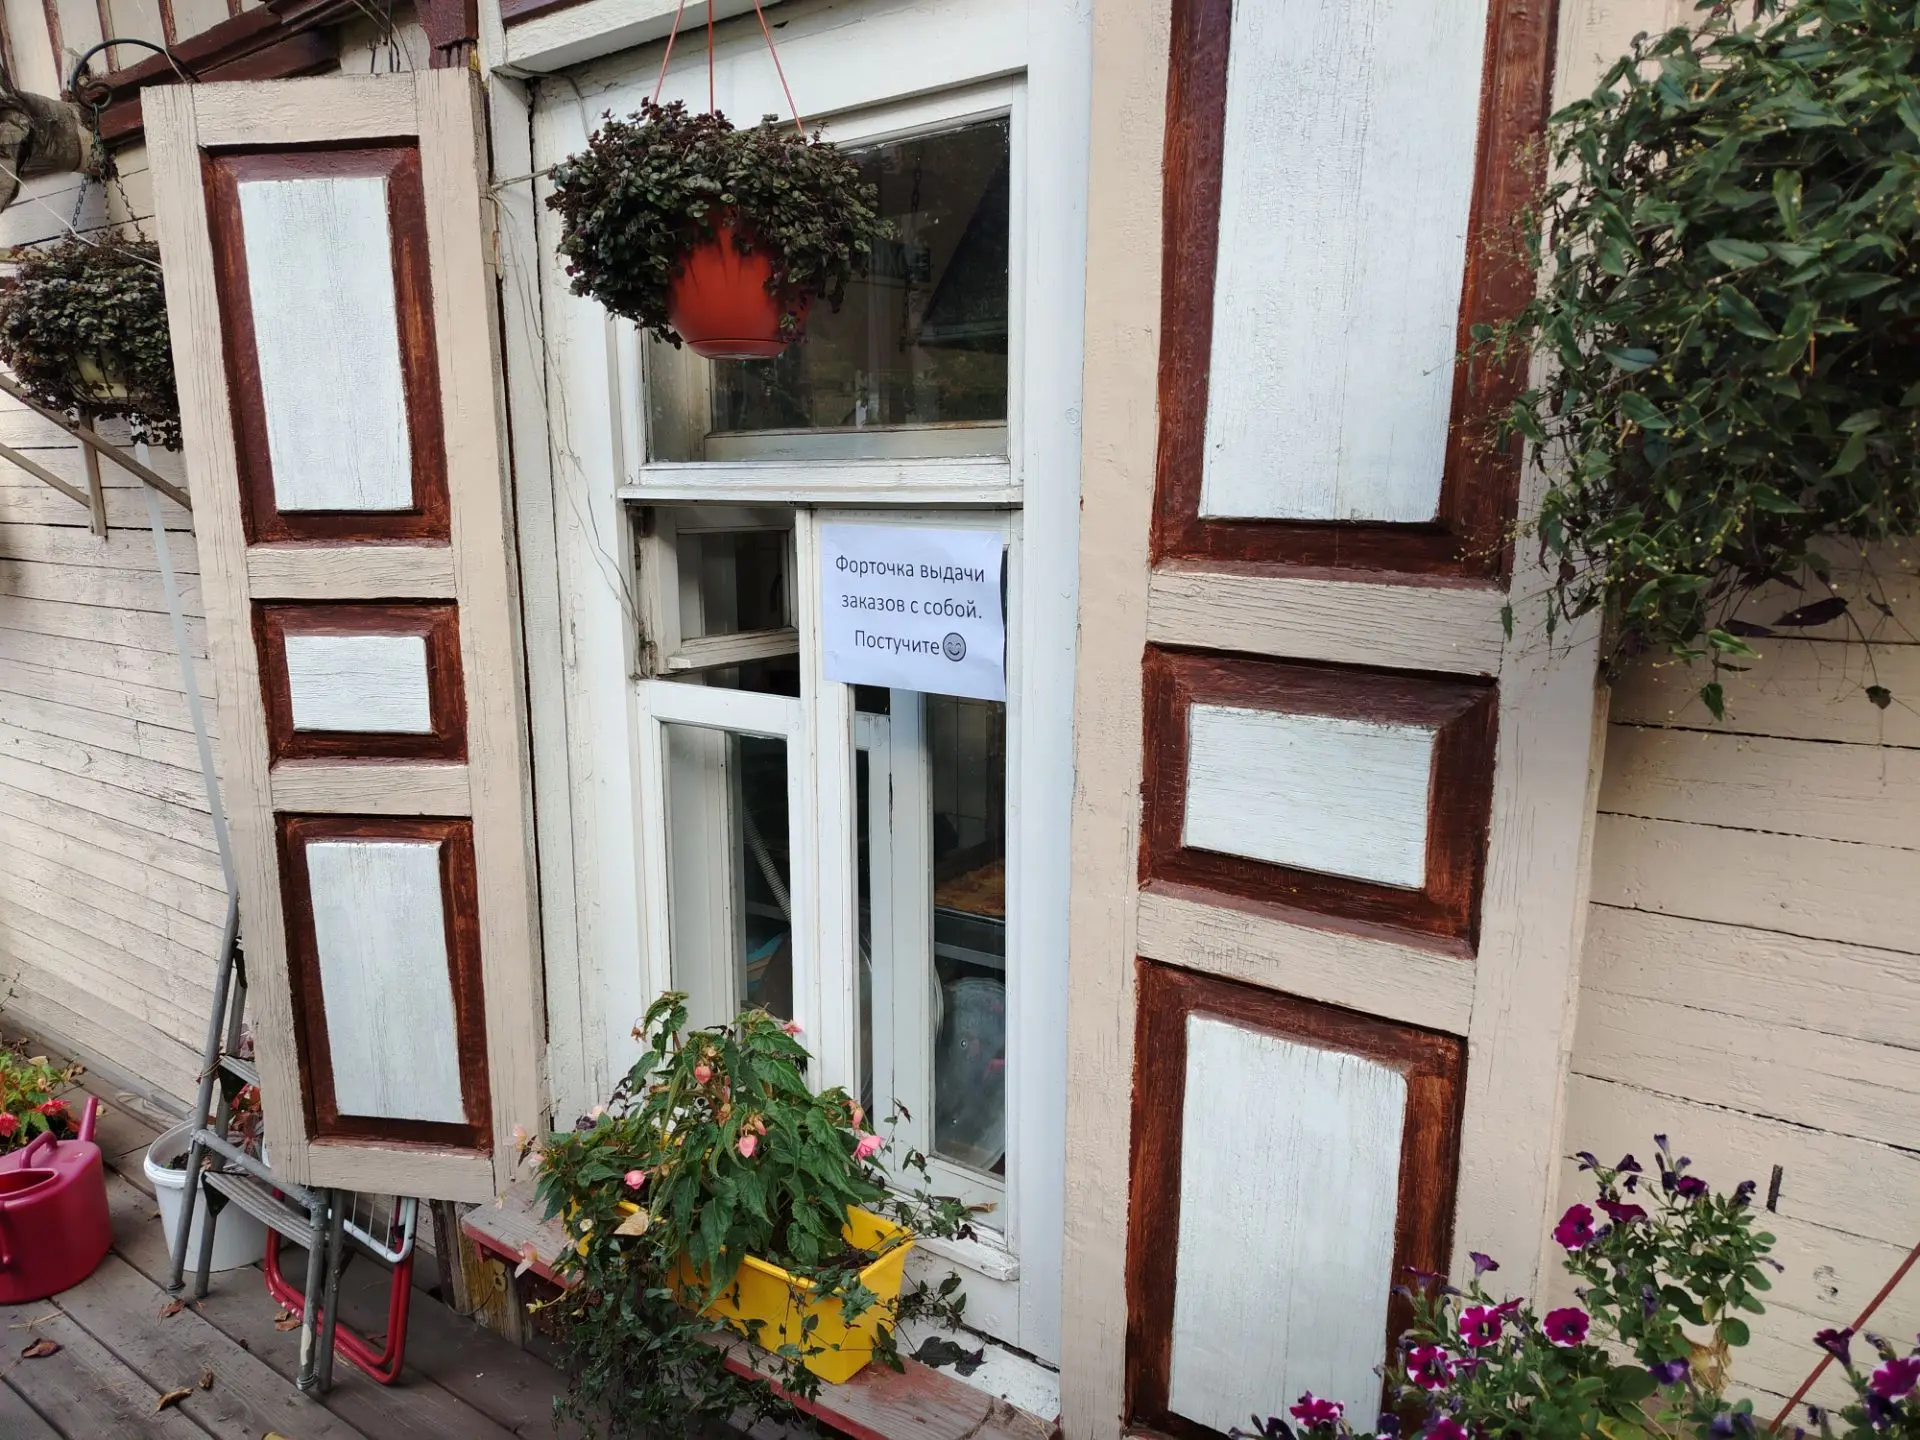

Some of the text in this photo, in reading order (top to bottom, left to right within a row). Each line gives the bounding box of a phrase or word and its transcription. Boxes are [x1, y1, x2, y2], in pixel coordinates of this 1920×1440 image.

[835, 554, 985, 584] Форточка выдачи
[841, 594, 982, 619] заказов с собой.
[854, 629, 940, 655] Постучите
